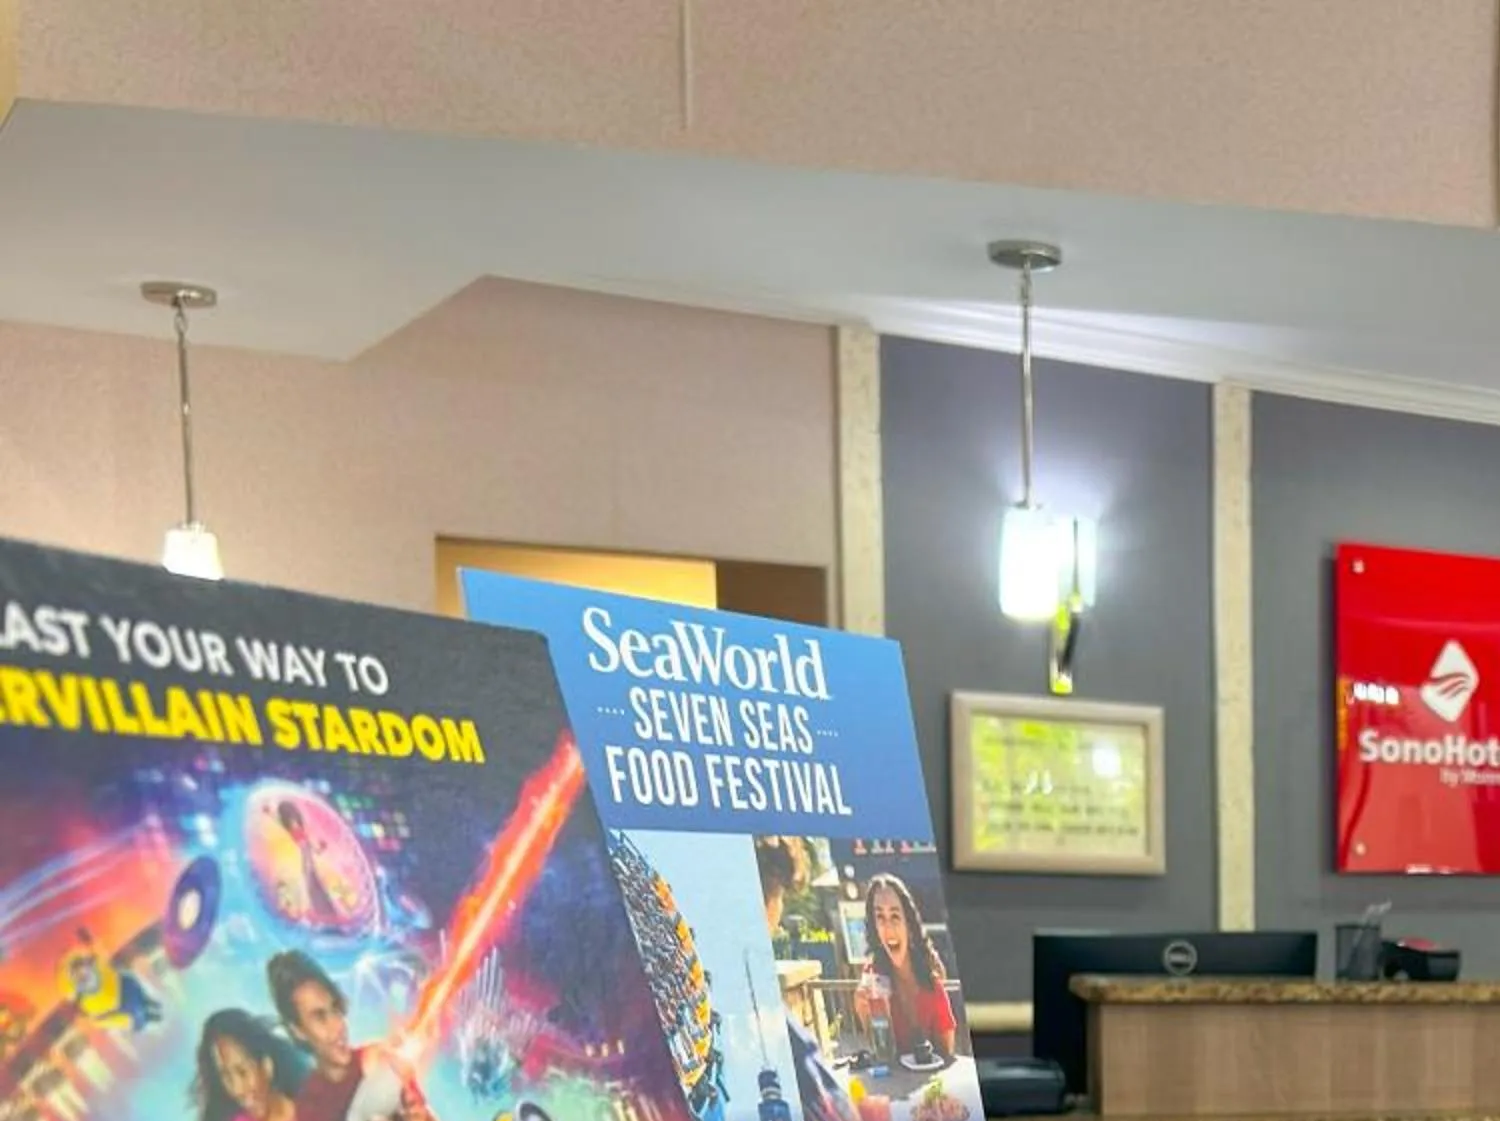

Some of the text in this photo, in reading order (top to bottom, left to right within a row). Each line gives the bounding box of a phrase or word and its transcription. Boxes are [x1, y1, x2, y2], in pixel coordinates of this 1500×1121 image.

[100, 614, 233, 678] YOUR
[236, 636, 327, 688] WAY
[335, 652, 389, 695] TO
[582, 607, 831, 701] SeaWorld
[0, 666, 486, 764] RVILLAIN STARDOM
[630, 687, 814, 755] SEVEN SEAS
[605, 745, 853, 817] FOOD FESTIVAL
